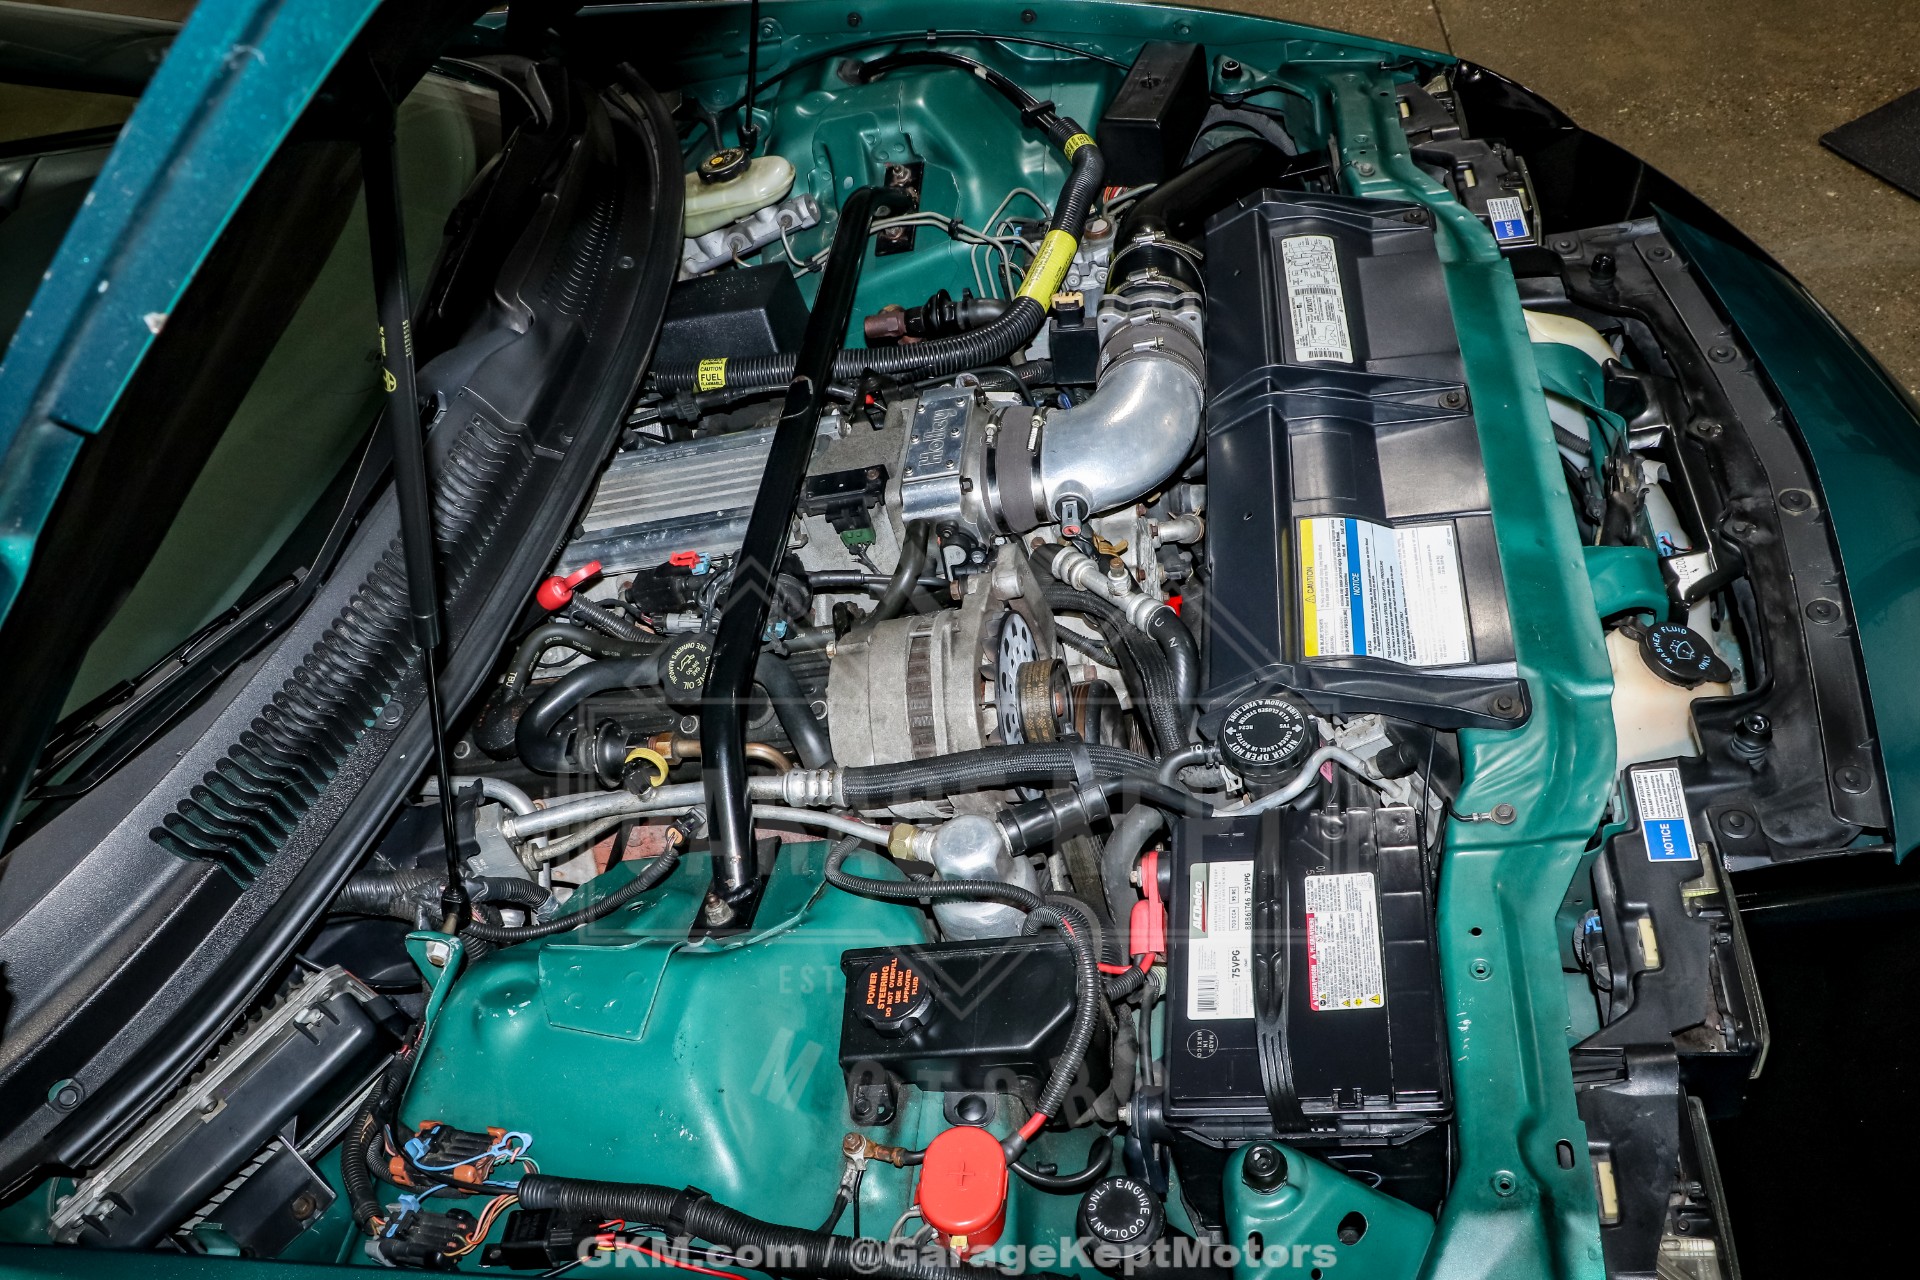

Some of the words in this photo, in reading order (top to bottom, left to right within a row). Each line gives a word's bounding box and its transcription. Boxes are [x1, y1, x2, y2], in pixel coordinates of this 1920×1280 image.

[1505, 222, 1514, 236] NOTICE
[700, 373, 721, 381] FUEL
[918, 408, 956, 466] Holley
[1351, 572, 1360, 595] NOTICE
[1660, 626, 1686, 634] FLUID
[695, 642, 706, 652] SEE
[1652, 632, 1672, 664] WASHER
[1698, 655, 1710, 669] ONLY
[505, 671, 517, 687] TBU
[668, 660, 677, 684] MANUAL
[683, 681, 694, 689] OIL
[1241, 700, 1258, 710] VENT
[1264, 699, 1287, 707] ARROW
[1227, 707, 1242, 722] TUBE
[1237, 709, 1256, 724] SYSTEM
[1285, 705, 1301, 719] ALIGN
[1235, 732, 1251, 748] BOTTLE
[1278, 730, 1292, 746] CHECK
[1228, 742, 1247, 756] HOT
[1244, 752, 1269, 760] OPEN
[1259, 744, 1277, 752] LEVEL
[1272, 739, 1298, 758] NEVER
[1659, 823, 1674, 855] NOTICE
[1243, 872, 1251, 893] 75VPG
[1192, 881, 1202, 929] ACDelco
[1230, 949, 1240, 978] 75VPG
[866, 972, 877, 1004] POWER
[877, 965, 889, 1008] STEERING
[885, 1007, 891, 1016] DO
[889, 957, 897, 987] OVERFILL
[903, 969, 911, 1003] APPROVED
[1087, 1181, 1110, 1210] ONLY
[1115, 1178, 1149, 1214] ENGINE
